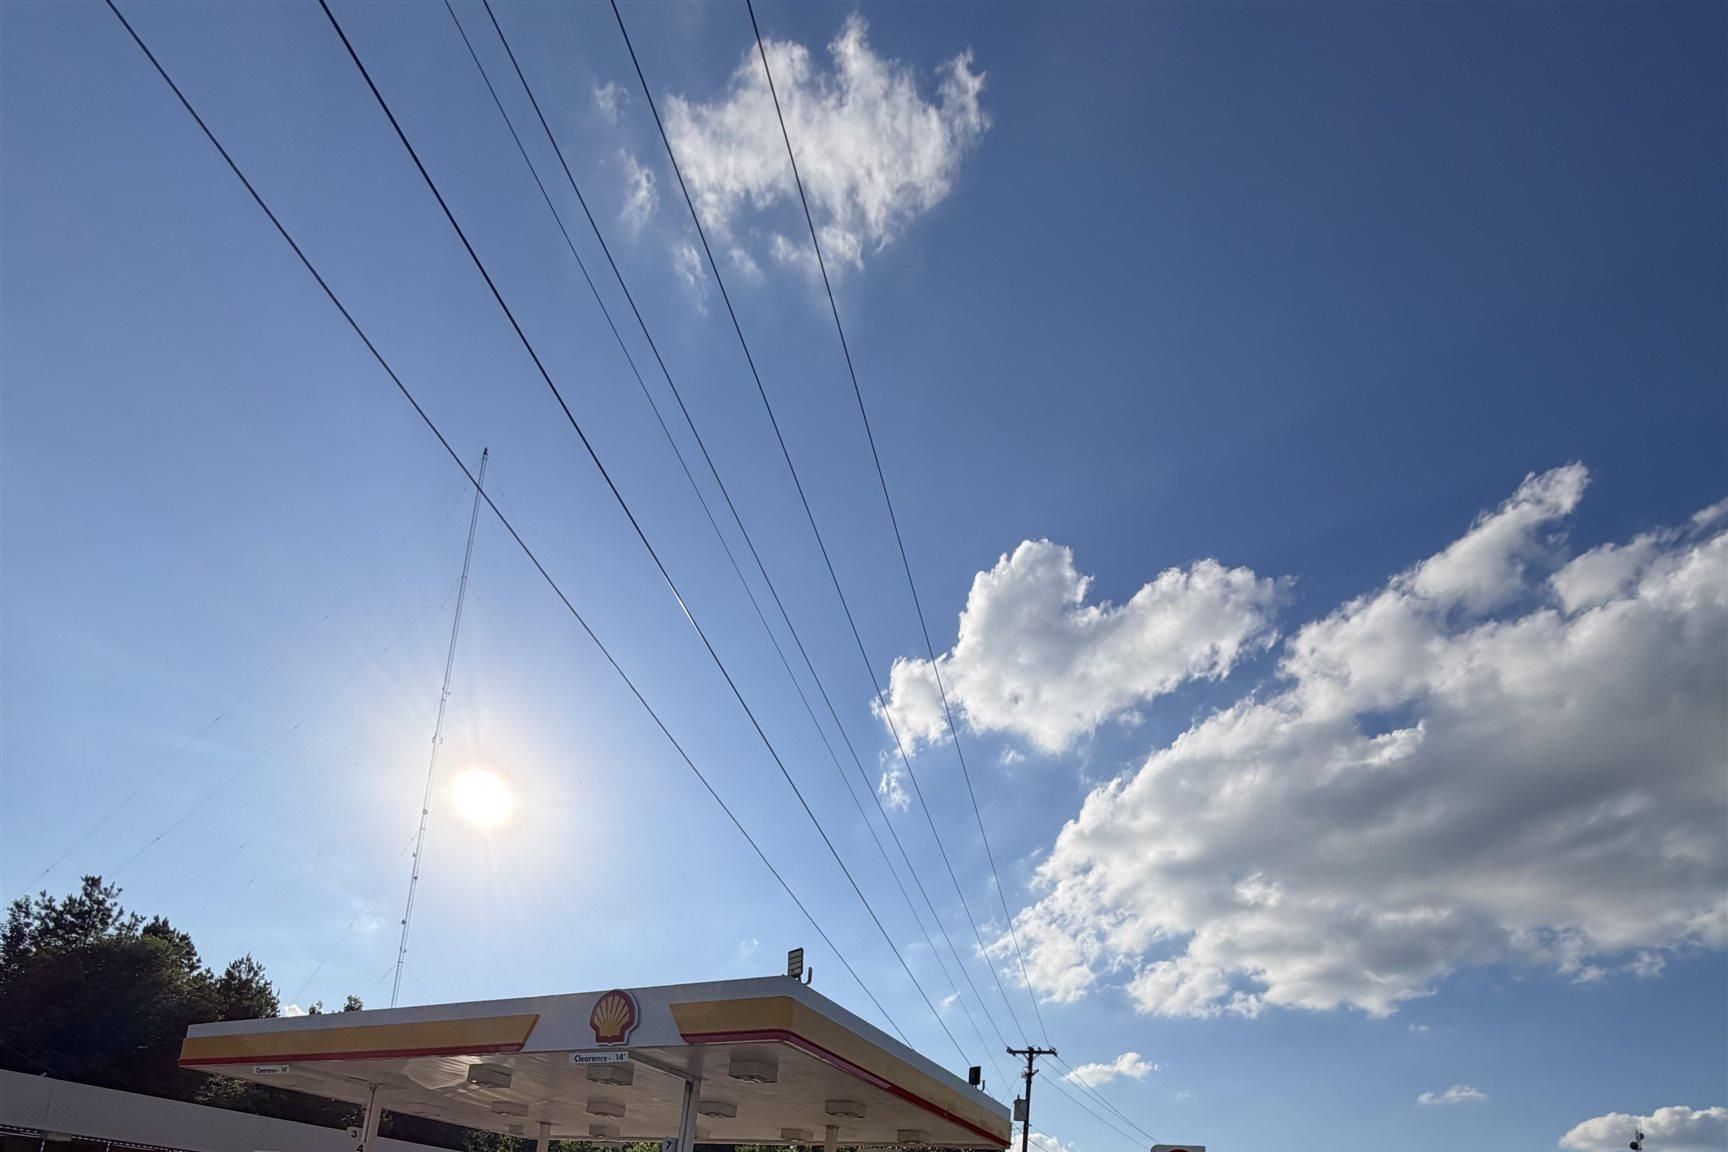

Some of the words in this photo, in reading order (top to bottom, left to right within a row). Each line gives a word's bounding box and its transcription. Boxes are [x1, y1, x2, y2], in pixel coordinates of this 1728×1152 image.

[574, 1054, 607, 1063] Clearance
[351, 1130, 357, 1138] 3
[356, 1144, 364, 1152] 4
[665, 1142, 672, 1150] 7
